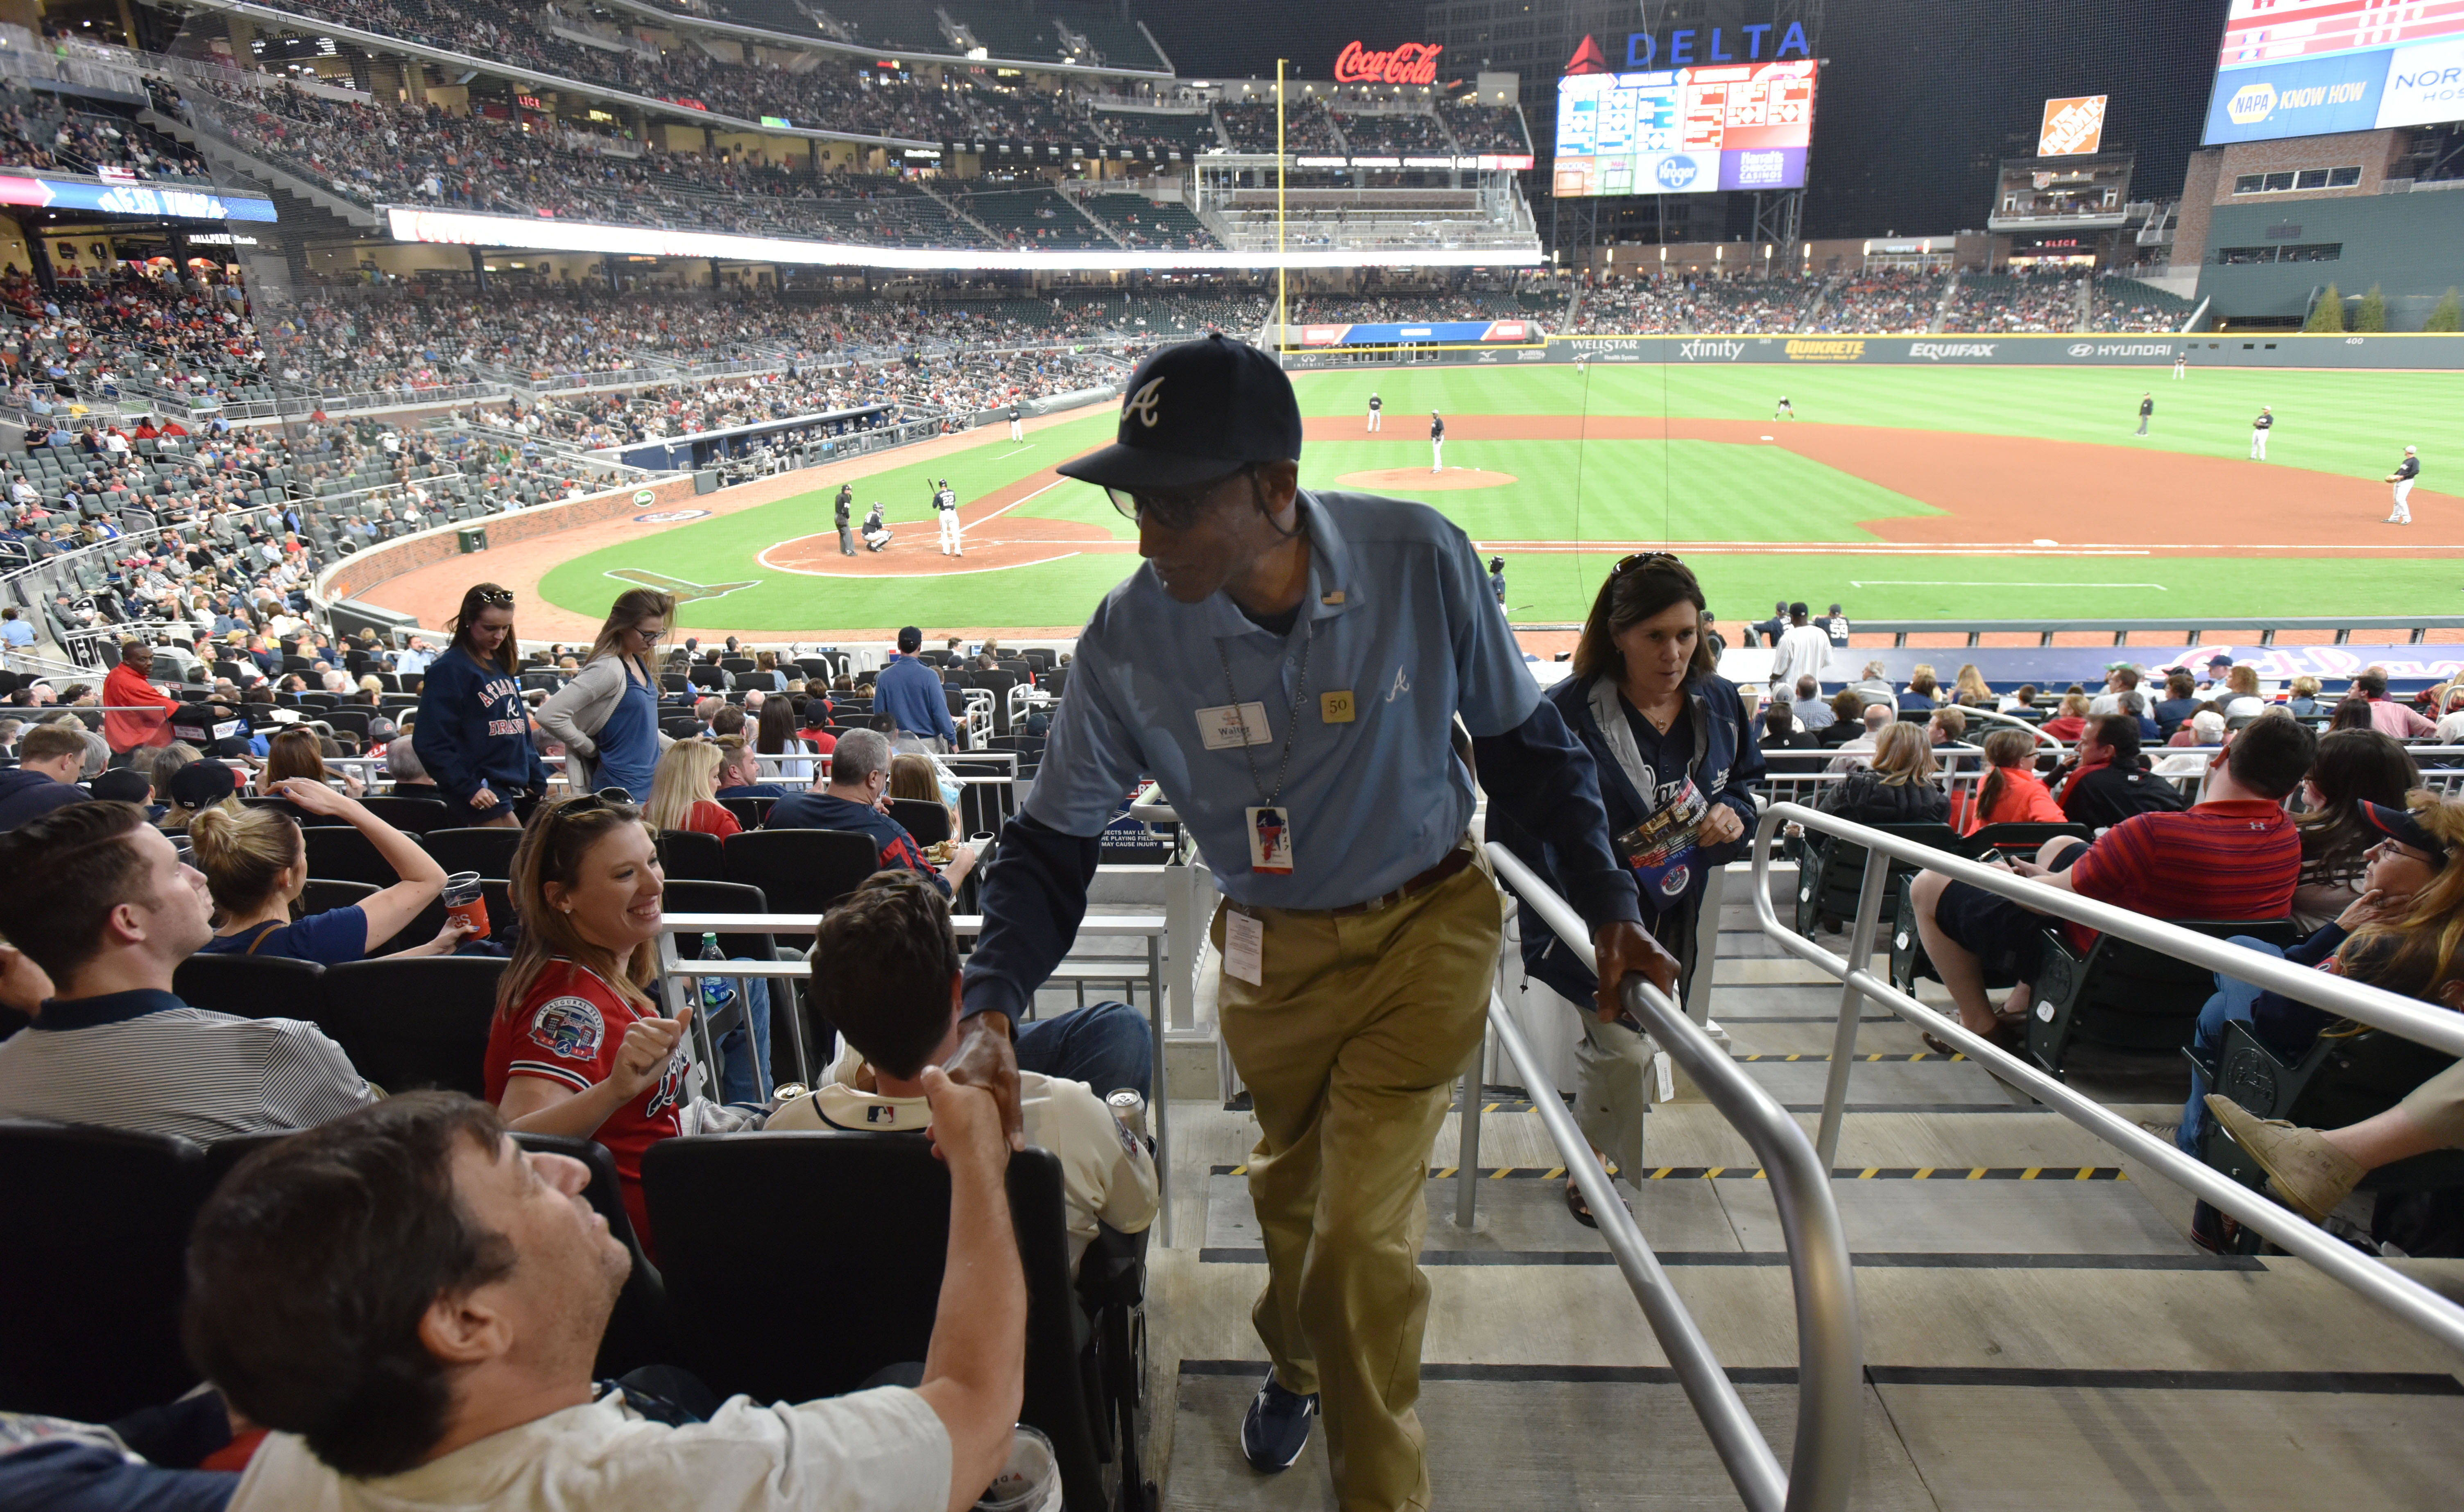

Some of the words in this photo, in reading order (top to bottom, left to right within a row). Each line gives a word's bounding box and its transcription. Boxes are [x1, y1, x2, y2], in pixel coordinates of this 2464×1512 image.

[1627, 21, 1810, 67] DELTA
[1335, 41, 1443, 84] Coca-Cola
[2235, 94, 2269, 113] NAPA
[2279, 86, 2328, 110] KNOW
[2329, 81, 2367, 104] HOW
[2049, 104, 2076, 128] THE
[2040, 97, 2104, 155] HOME
[2062, 117, 2100, 154] DEPOT
[1658, 159, 1696, 187] Kroger
[1739, 171, 1782, 180] CASINOS
[2045, 239, 2078, 247] SLICE
[1572, 340, 1638, 352] WELLSTAR
[1680, 339, 1745, 361] xfinity
[1785, 340, 1864, 355] QUIKRETE
[1909, 343, 1995, 361] EQUIFAX
[2097, 344, 2172, 356] HYUNDAI
[943, 496, 954, 506] 22
[1830, 623, 1848, 639] 59
[1329, 699, 1348, 714] 50
[1676, 792, 1696, 815] YANKEES
[1687, 807, 1704, 827] BRAVES
[540, 999, 587, 1017] INAUGURAL
[589, 1009, 602, 1038] SEASON
[2041, 1005, 2048, 1016] 3
